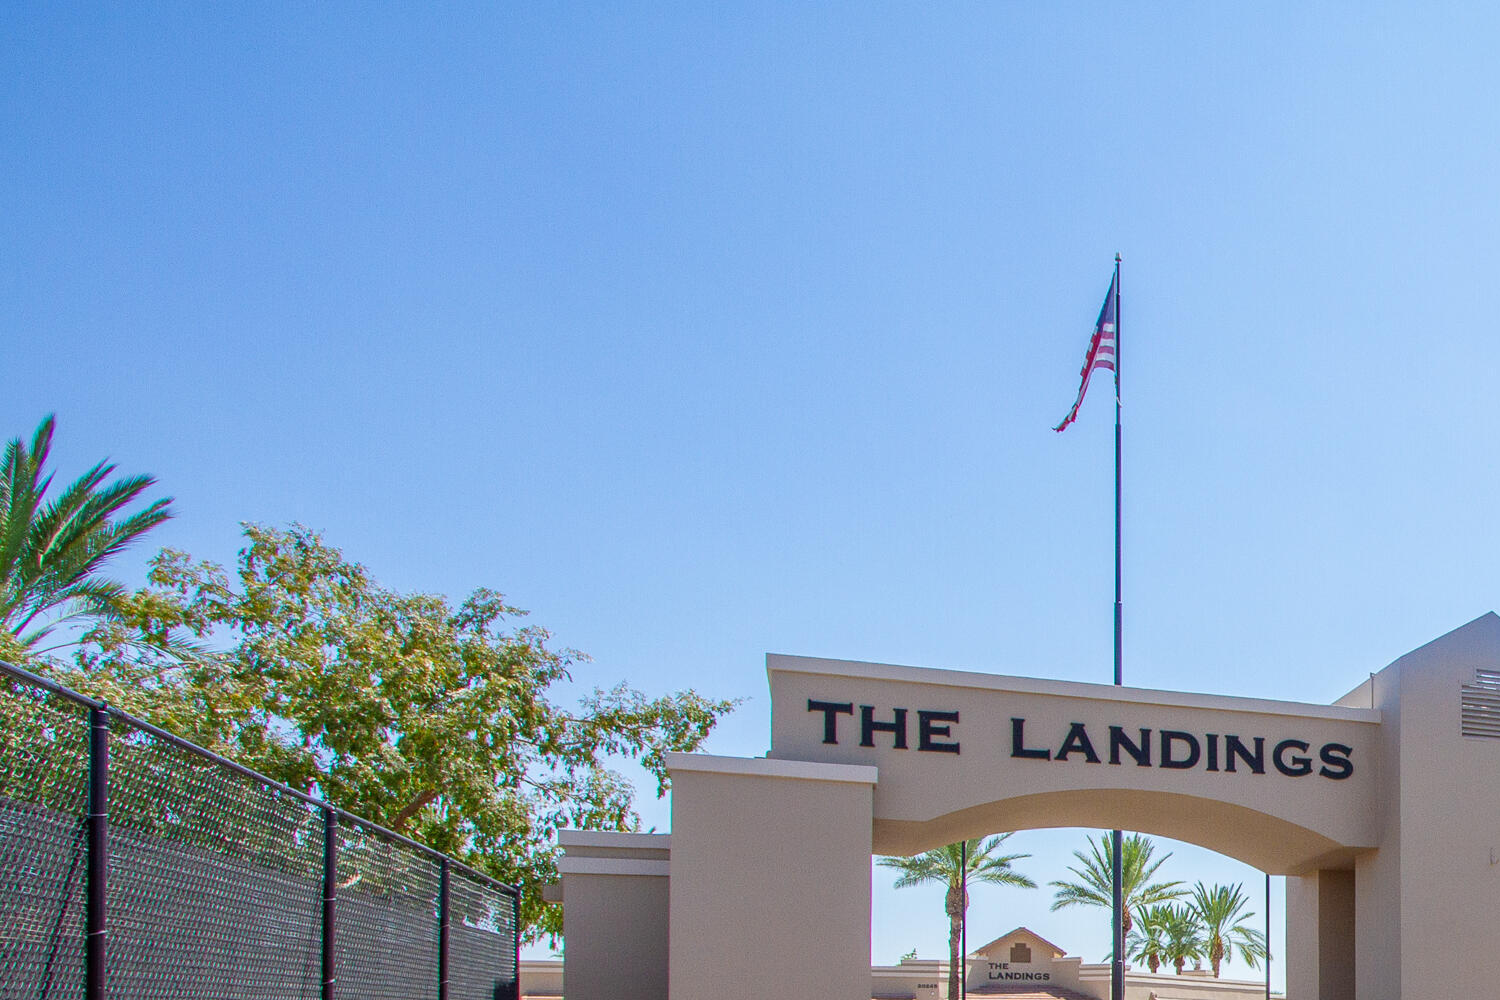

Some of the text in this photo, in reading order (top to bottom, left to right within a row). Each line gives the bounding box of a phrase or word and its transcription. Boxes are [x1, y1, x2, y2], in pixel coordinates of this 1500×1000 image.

[807, 699, 1354, 781] THE LANDINGS
[988, 962, 1009, 970] THE
[988, 971, 1050, 981] LANDINGS
